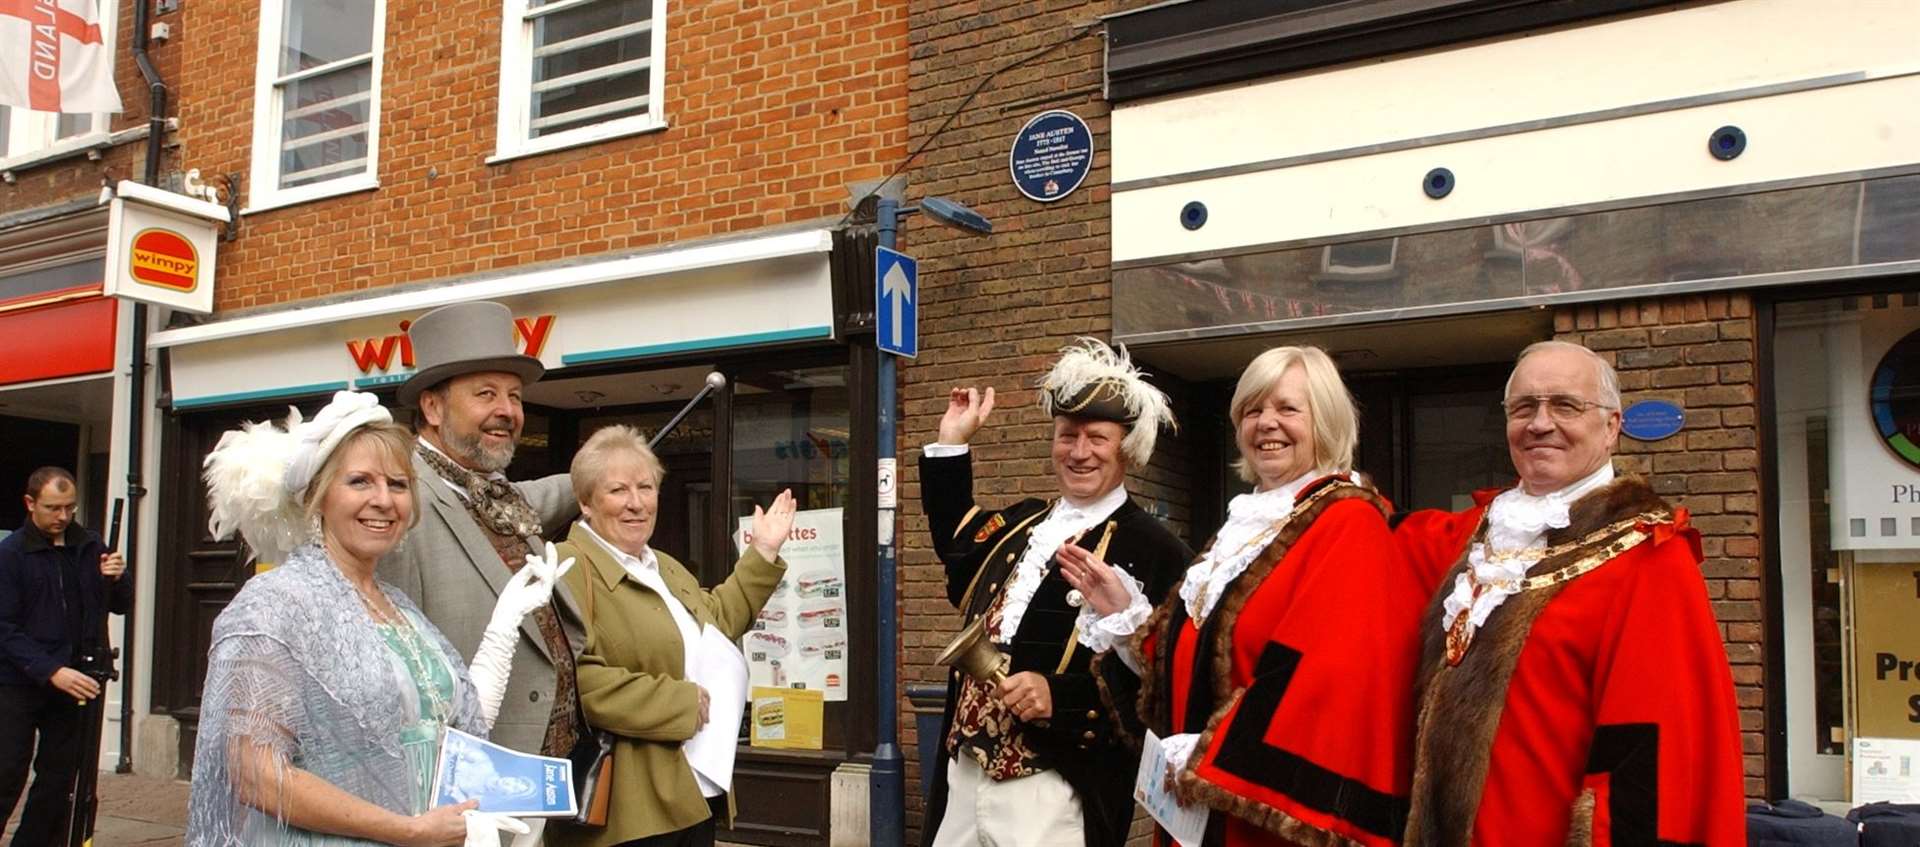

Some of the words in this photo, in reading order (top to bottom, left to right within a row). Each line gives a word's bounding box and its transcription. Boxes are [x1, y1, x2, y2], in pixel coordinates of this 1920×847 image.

[134, 252, 194, 274] wimpy
[346, 315, 556, 374] wiy
[743, 527, 817, 544] bttes
